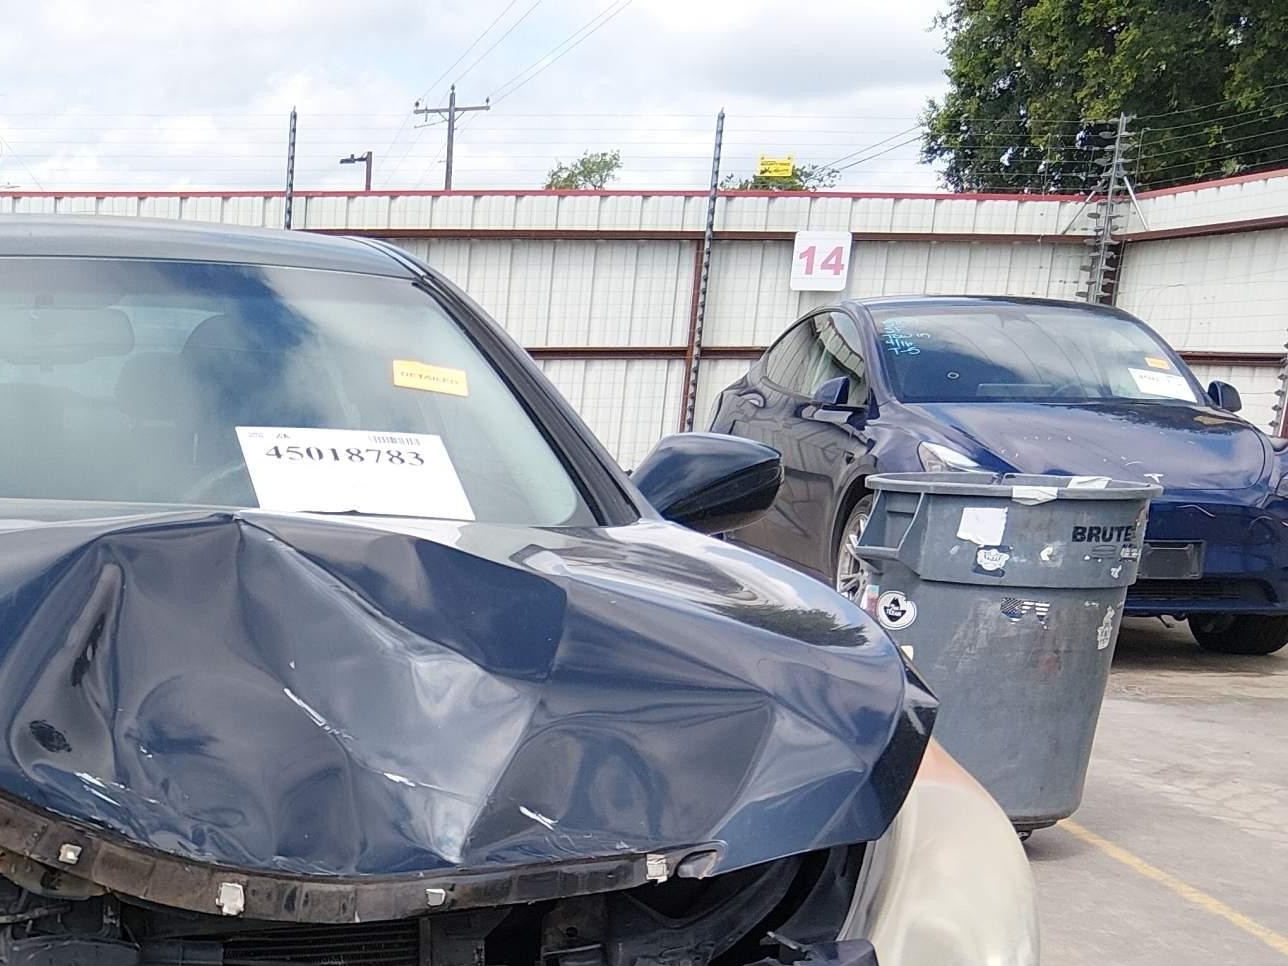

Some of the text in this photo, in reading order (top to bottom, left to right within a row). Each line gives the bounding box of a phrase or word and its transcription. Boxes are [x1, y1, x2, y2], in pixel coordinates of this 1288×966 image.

[799, 245, 845, 276] 14
[265, 445, 425, 467] 45018783
[1072, 525, 1137, 543] BRUTE
